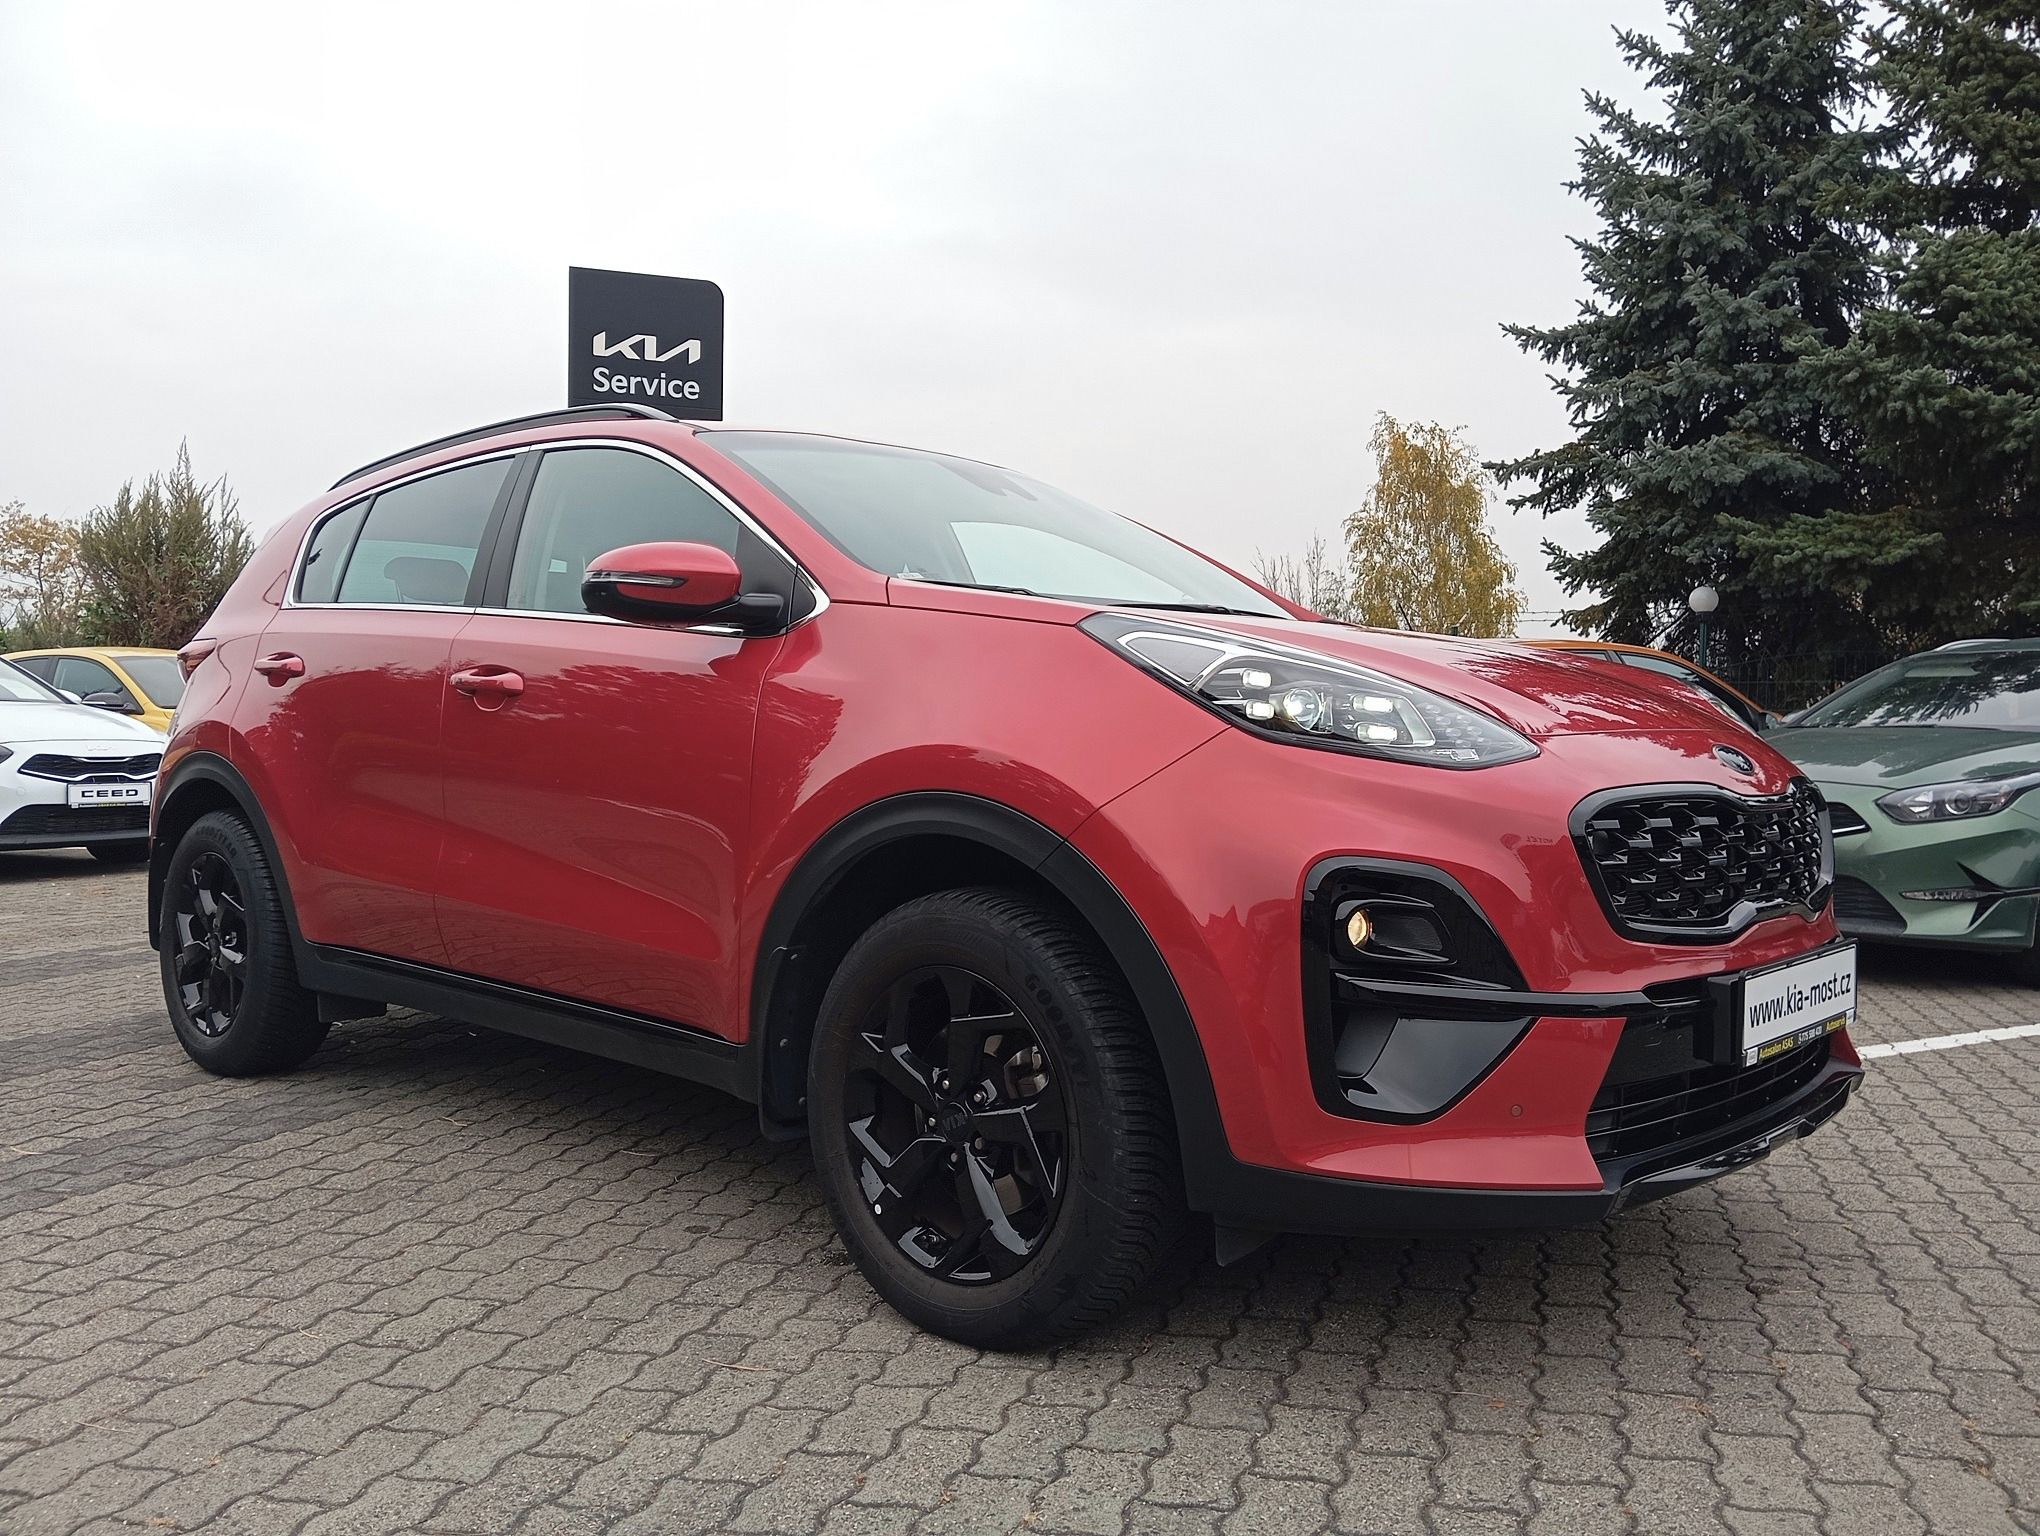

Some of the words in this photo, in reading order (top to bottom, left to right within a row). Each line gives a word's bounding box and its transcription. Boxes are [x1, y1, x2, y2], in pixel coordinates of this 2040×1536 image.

[593, 331, 701, 364] KIA
[593, 367, 700, 399] Service
[81, 789, 138, 798] CEED
[1749, 972, 1851, 1028] www.kia-most.cz
